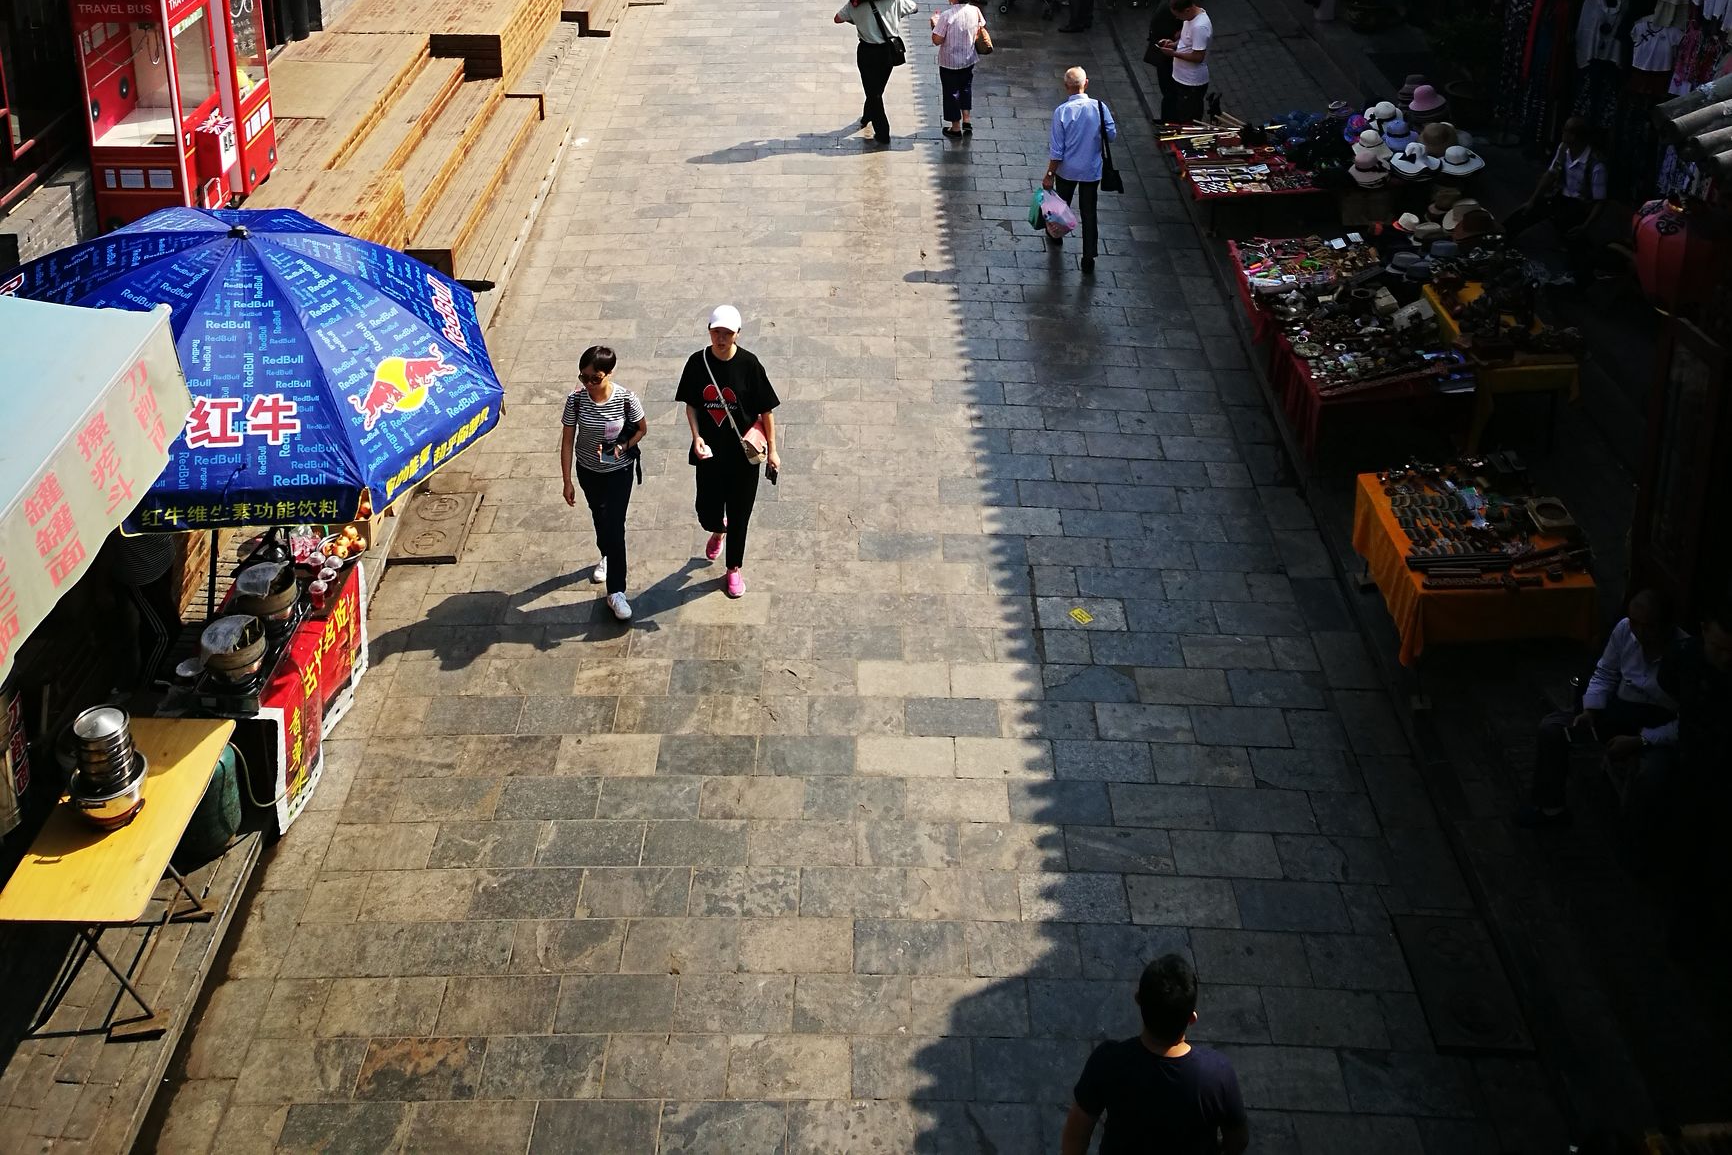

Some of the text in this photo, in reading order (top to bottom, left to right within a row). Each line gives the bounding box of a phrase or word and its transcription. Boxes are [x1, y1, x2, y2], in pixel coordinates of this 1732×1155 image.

[78, 3, 153, 15] TRAVEL BUS
[160, 282, 193, 300] RedBull
[233, 300, 274, 309] RedBull
[206, 320, 251, 329] RedBull
[369, 306, 399, 327] RedBull
[355, 321, 383, 352] RedBull
[243, 352, 255, 388] RedBull
[262, 355, 304, 365] RedBull
[276, 380, 312, 389] RedBull
[338, 367, 369, 391] RedBull
[123, 360, 167, 455] 刀削面
[446, 391, 480, 418] RedBull
[188, 395, 299, 446] 红牛
[379, 421, 405, 454] RedBull
[194, 454, 241, 465] RedBull
[291, 460, 329, 469] RedBull
[179, 452, 190, 490] RedBull
[273, 473, 327, 487] RedBull
[141, 499, 338, 527] 红牛维生素功能饮料
[23, 471, 86, 590] 罐罐面
